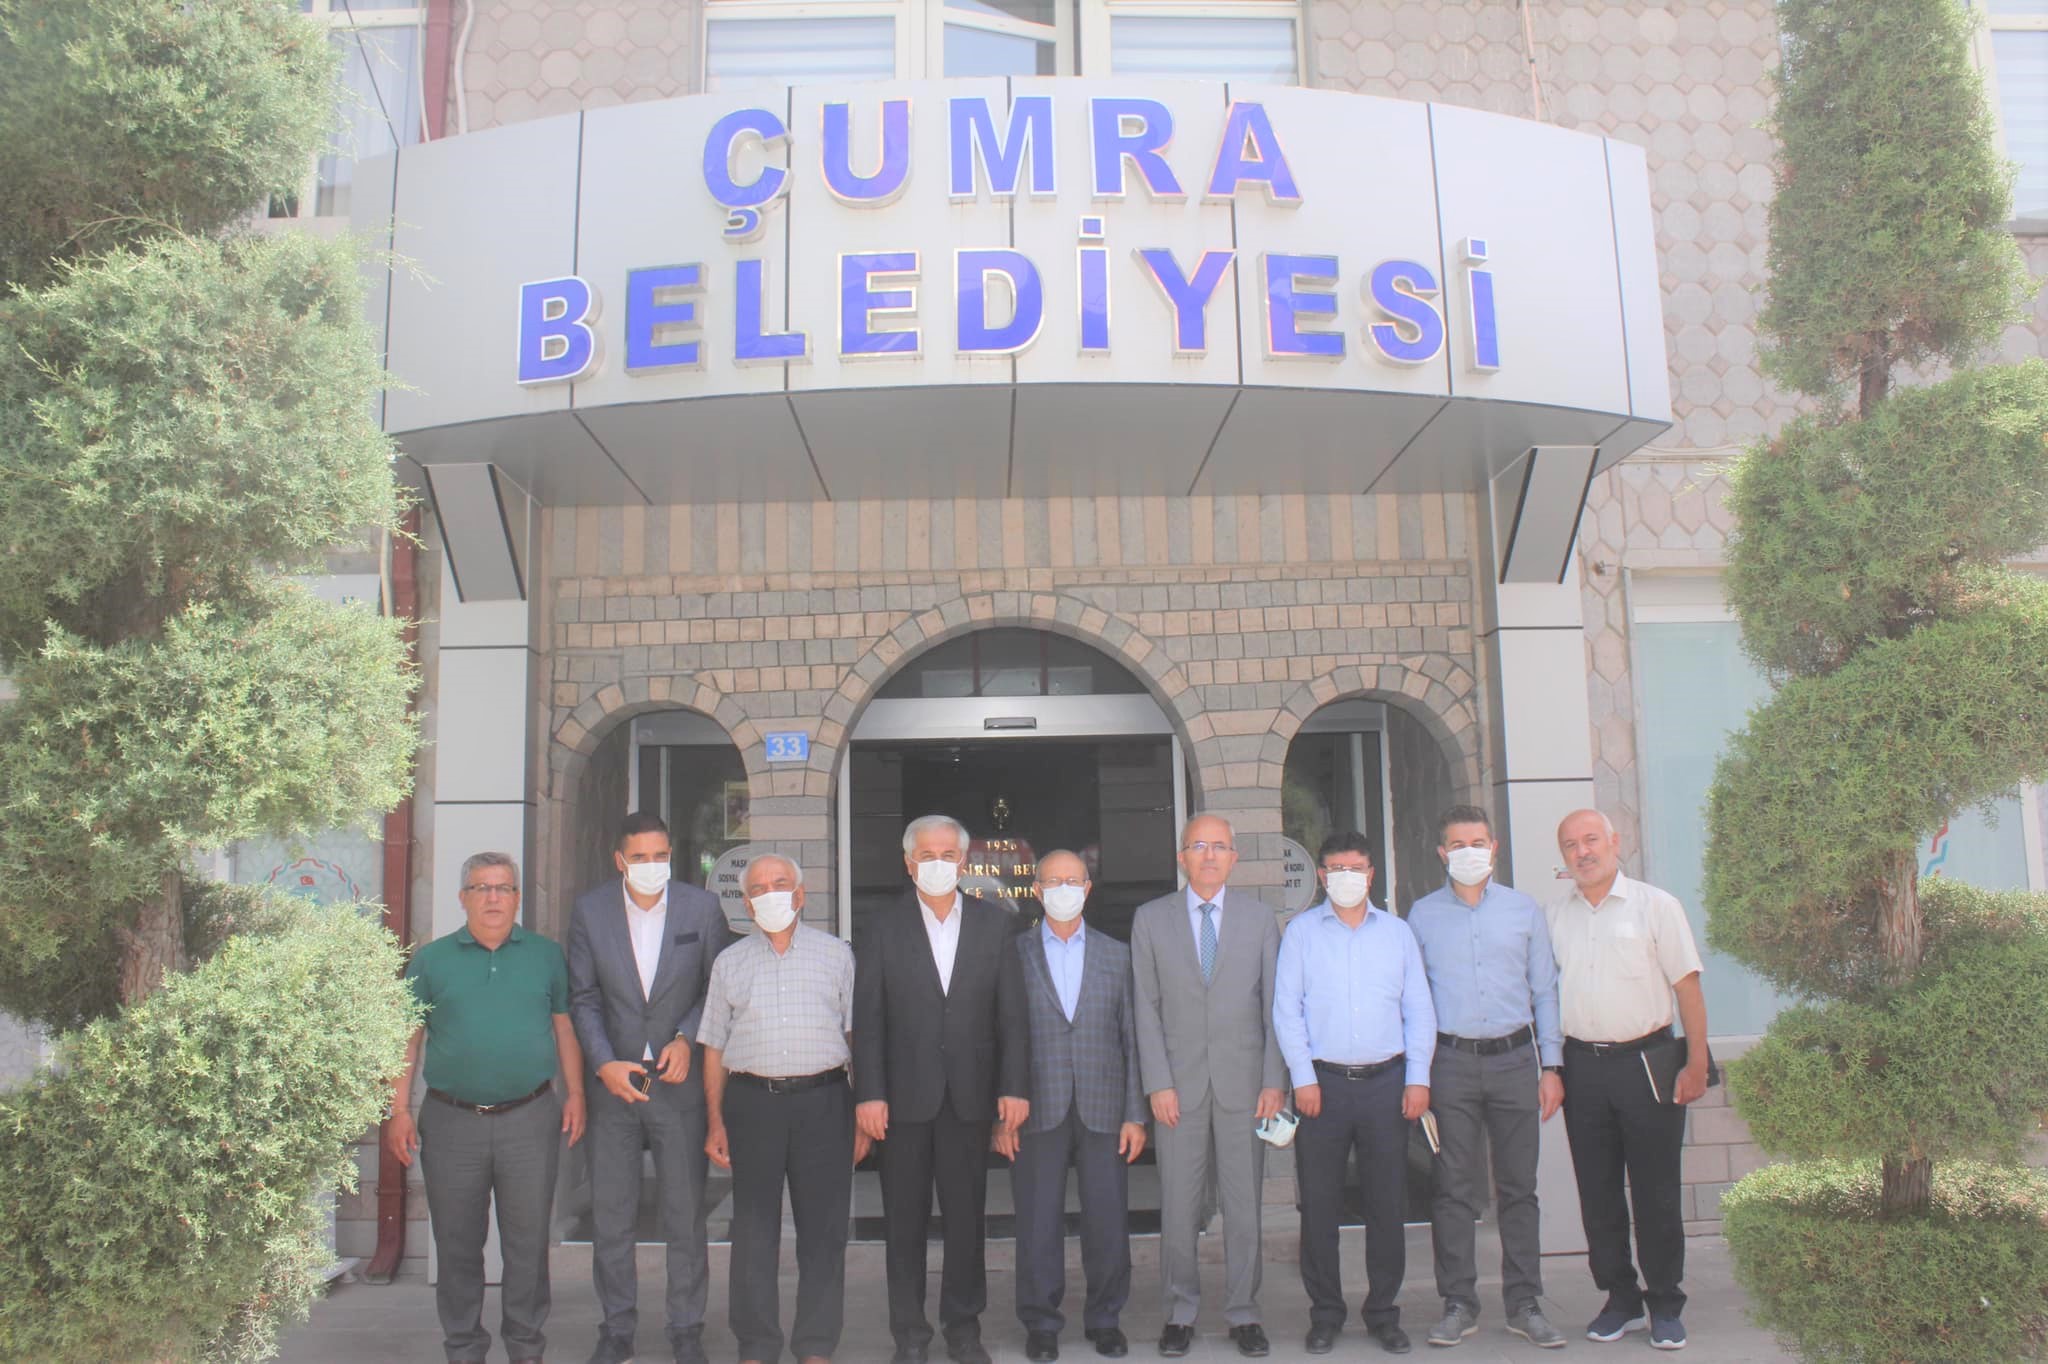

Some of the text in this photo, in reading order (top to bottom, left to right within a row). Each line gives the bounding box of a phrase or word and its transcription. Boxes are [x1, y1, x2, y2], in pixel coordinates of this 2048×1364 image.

[703, 96, 1303, 241] ÇUMRA
[517, 215, 1501, 388] BELEDİYESİ
[771, 736, 801, 756] 33
